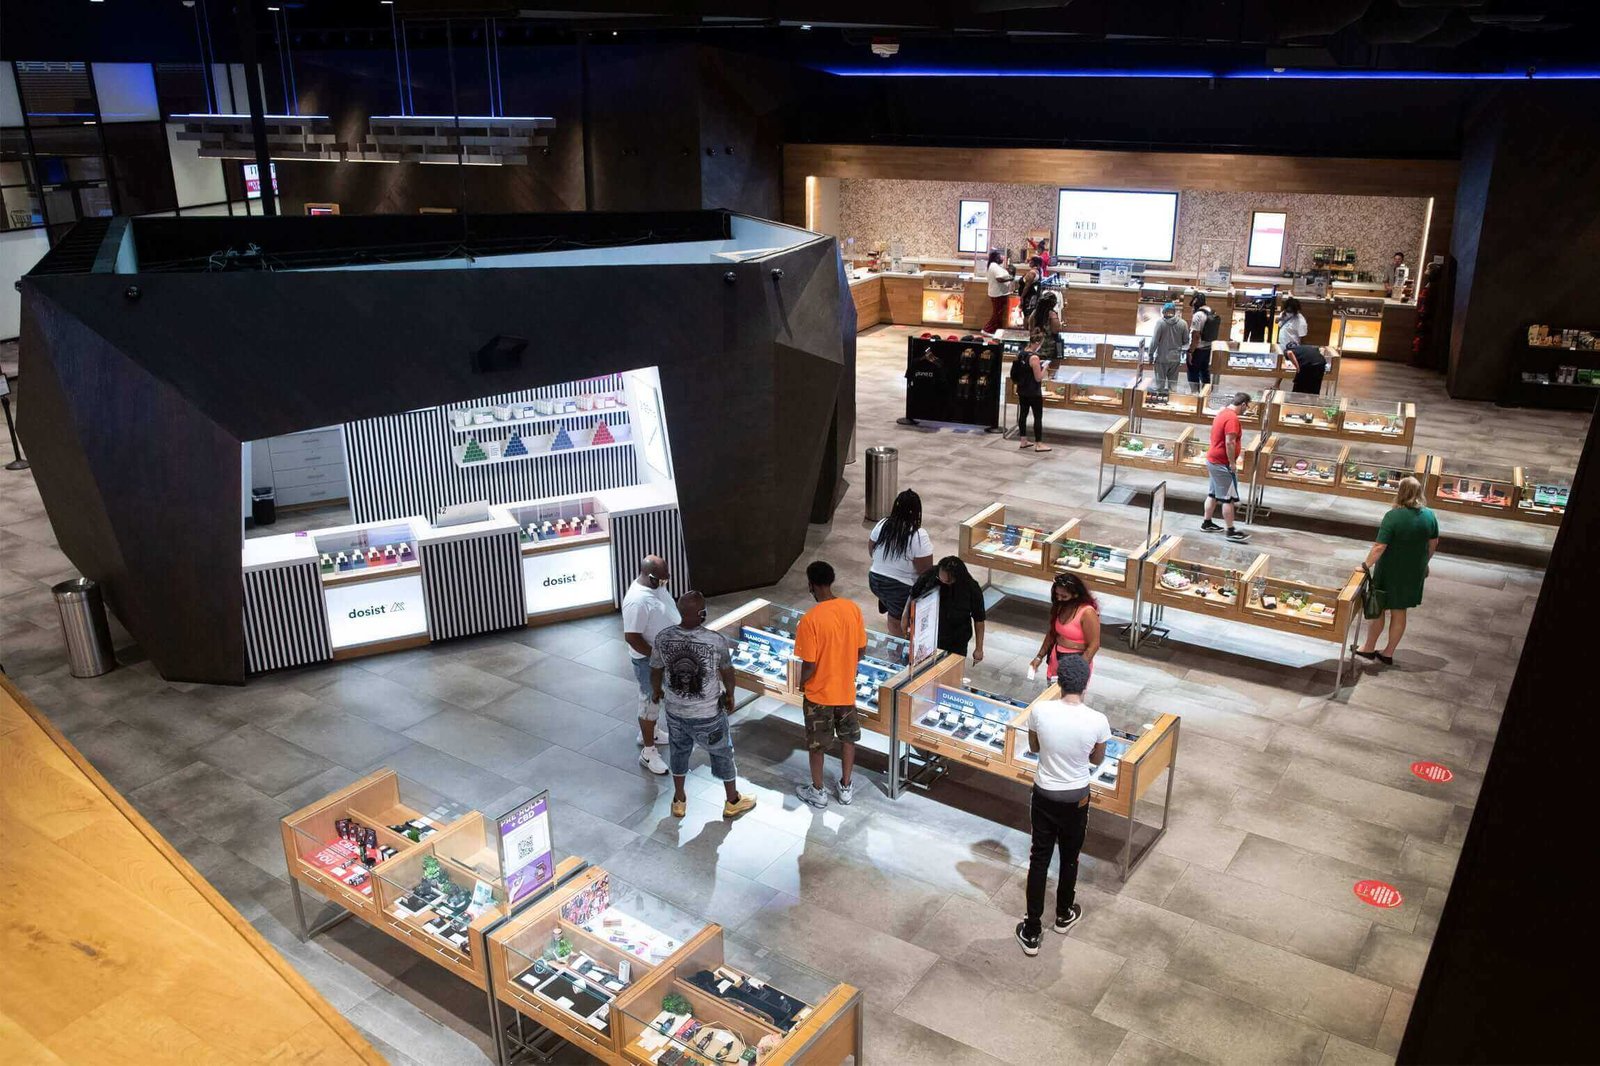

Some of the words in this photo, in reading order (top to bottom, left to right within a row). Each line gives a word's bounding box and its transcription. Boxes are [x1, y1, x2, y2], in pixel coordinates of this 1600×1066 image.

[1075, 221, 1098, 230] NEED
[1072, 231, 1099, 240] HELP?
[1540, 485, 1569, 497] ROVE
[543, 573, 577, 588] dosist
[348, 604, 386, 619] dosist
[942, 692, 974, 707] DIAMOND
[517, 810, 535, 825] CBD
[315, 851, 336, 865] YOU
